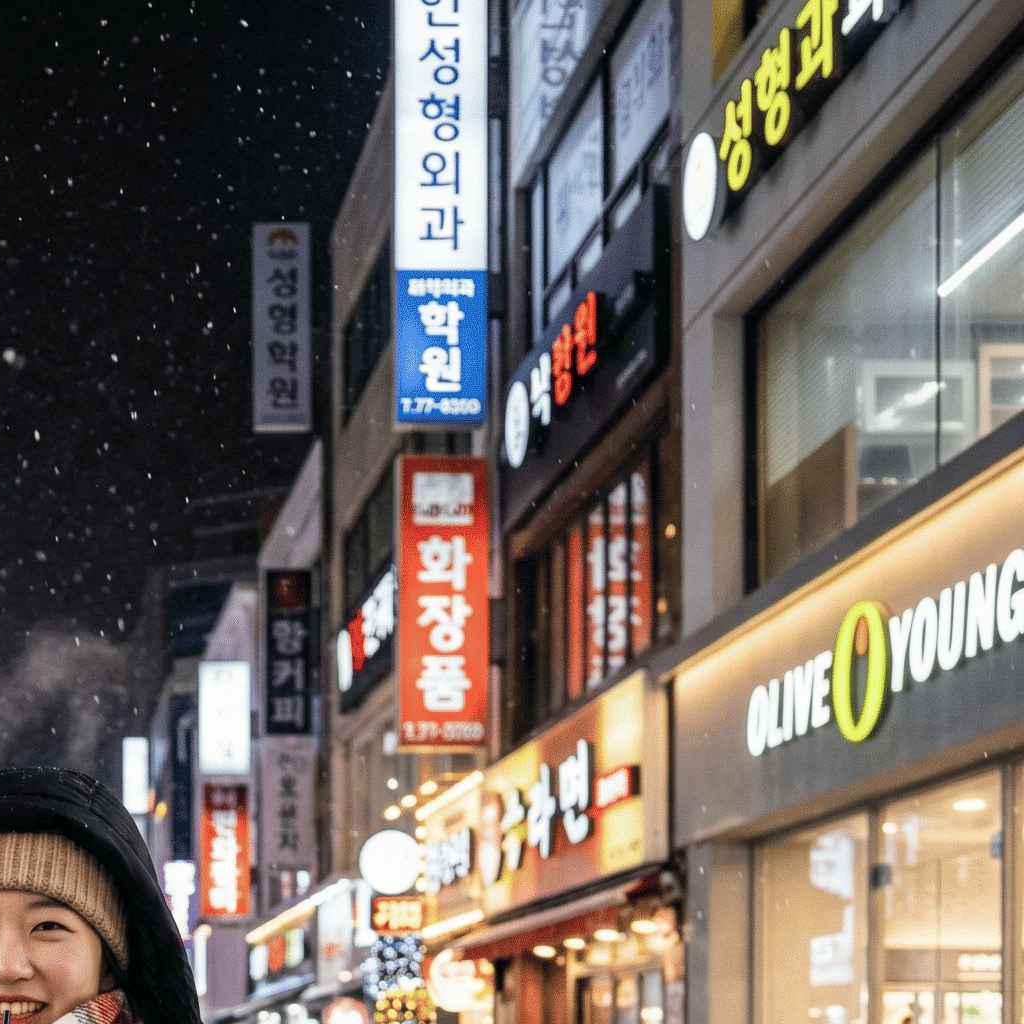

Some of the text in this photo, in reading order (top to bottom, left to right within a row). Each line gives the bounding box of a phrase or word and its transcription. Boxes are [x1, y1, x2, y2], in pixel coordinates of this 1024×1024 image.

[416, 535, 474, 713] 화장품
[747, 650, 833, 757] OLIVE
[888, 548, 1024, 692] YOUNG
